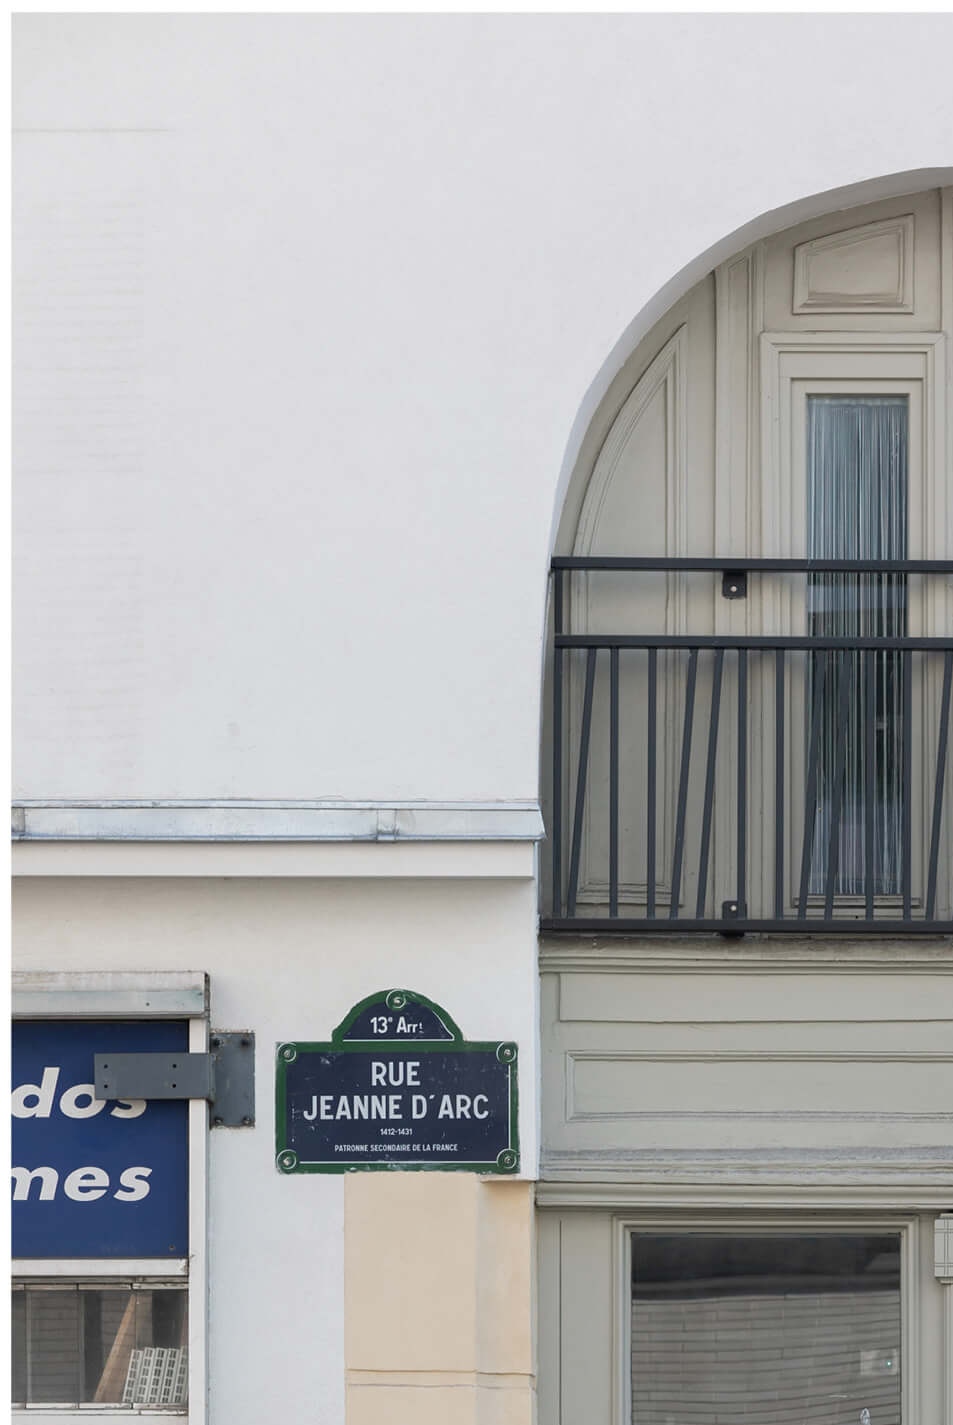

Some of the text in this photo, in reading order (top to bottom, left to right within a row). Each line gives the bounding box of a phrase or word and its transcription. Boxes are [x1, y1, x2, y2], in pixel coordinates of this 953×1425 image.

[371, 1061, 421, 1086] RUE
[303, 1095, 403, 1121] JEANNE
[380, 1128, 413, 1136] 1412-1431
[334, 1143, 459, 1152] PATRONNE SECONDAIRE DE LA FRANCE
